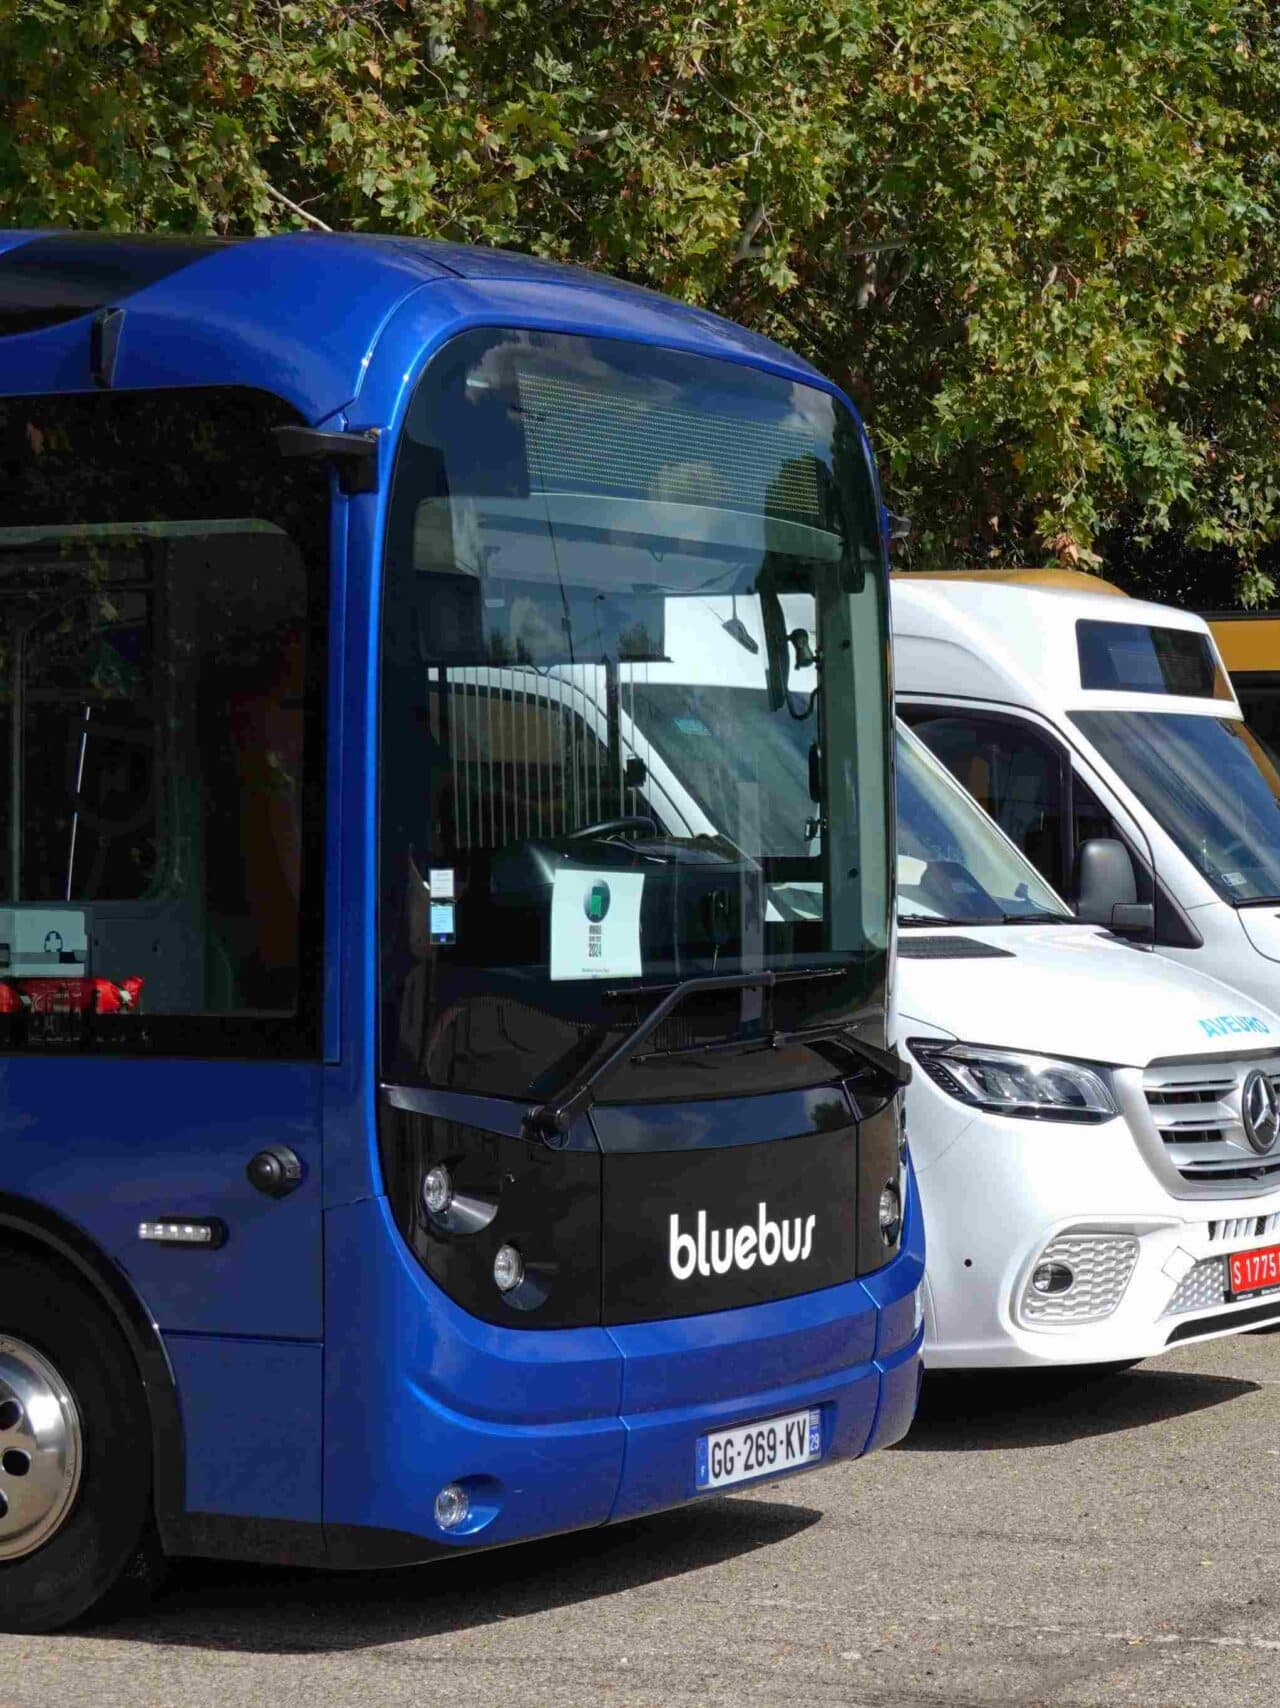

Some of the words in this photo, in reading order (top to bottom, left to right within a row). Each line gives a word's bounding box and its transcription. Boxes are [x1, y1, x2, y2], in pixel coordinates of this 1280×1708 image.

[669, 1202, 817, 1281] bluebus
[1233, 1261, 1243, 1285] S
[1246, 1253, 1277, 1283] 1775
